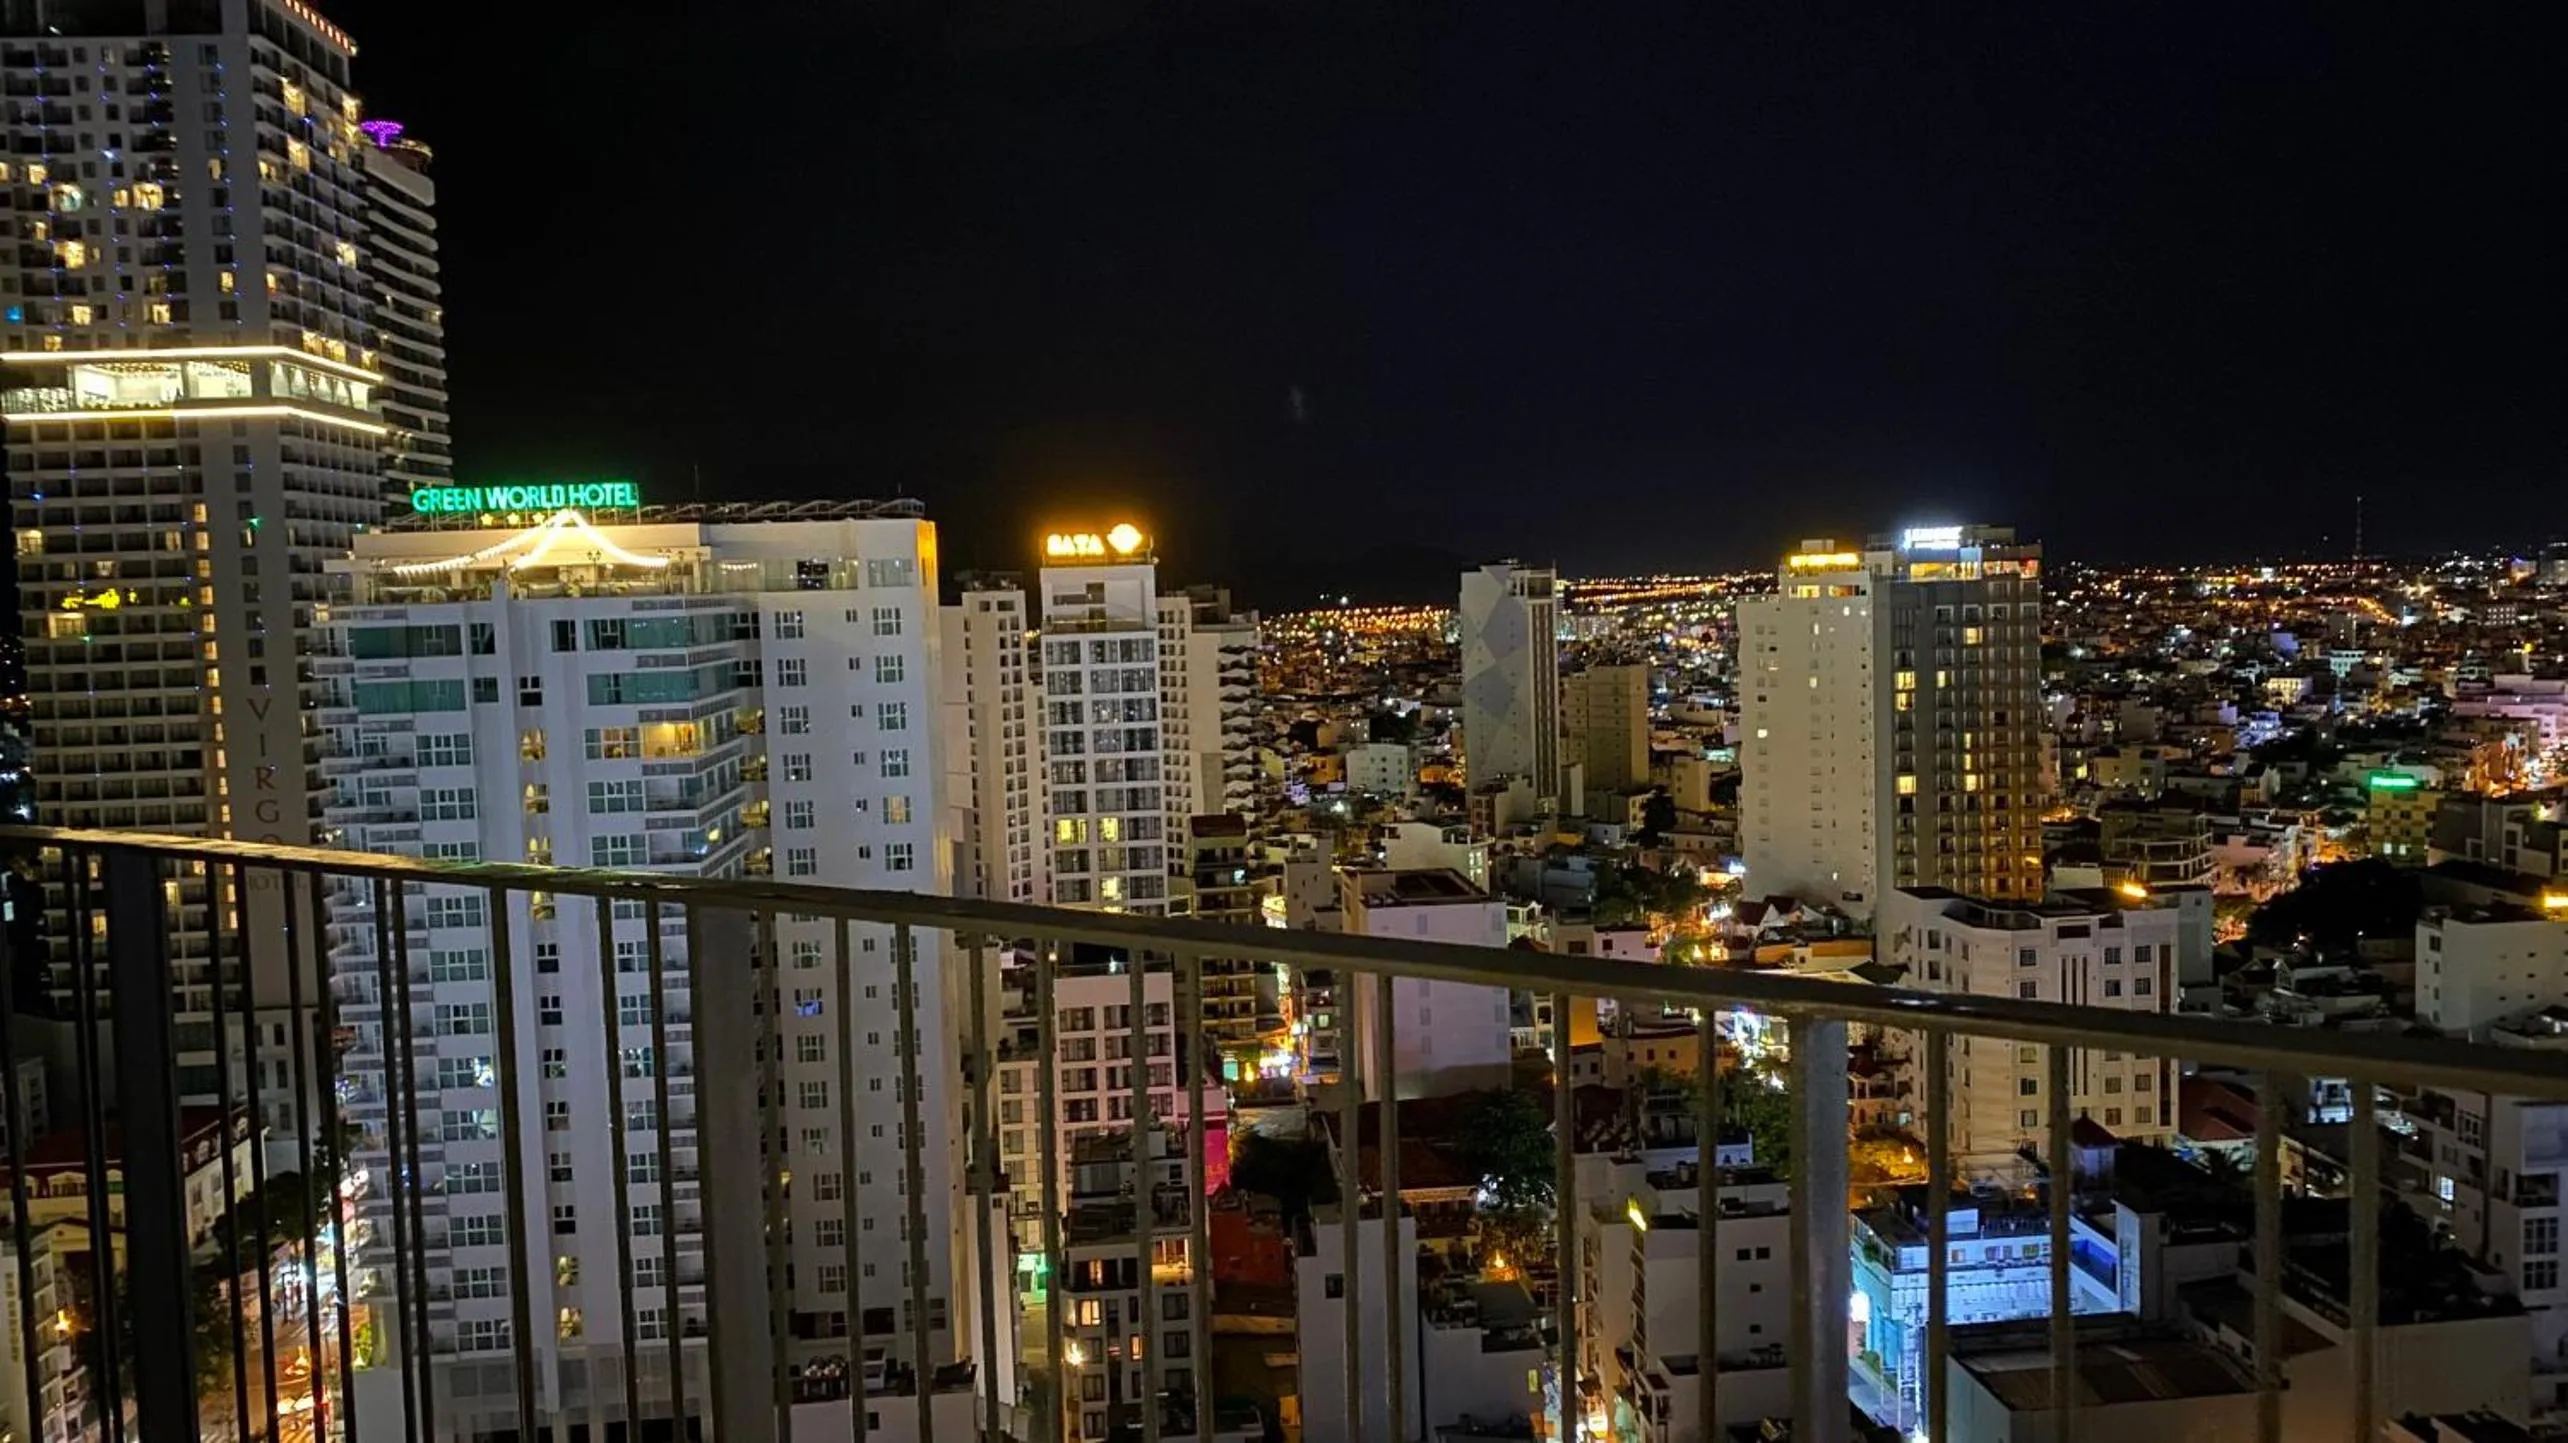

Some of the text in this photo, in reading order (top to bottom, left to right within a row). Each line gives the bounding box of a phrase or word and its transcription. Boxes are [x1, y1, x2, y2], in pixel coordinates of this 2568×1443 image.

[412, 483, 639, 512] GREEN WORLD HOTEL
